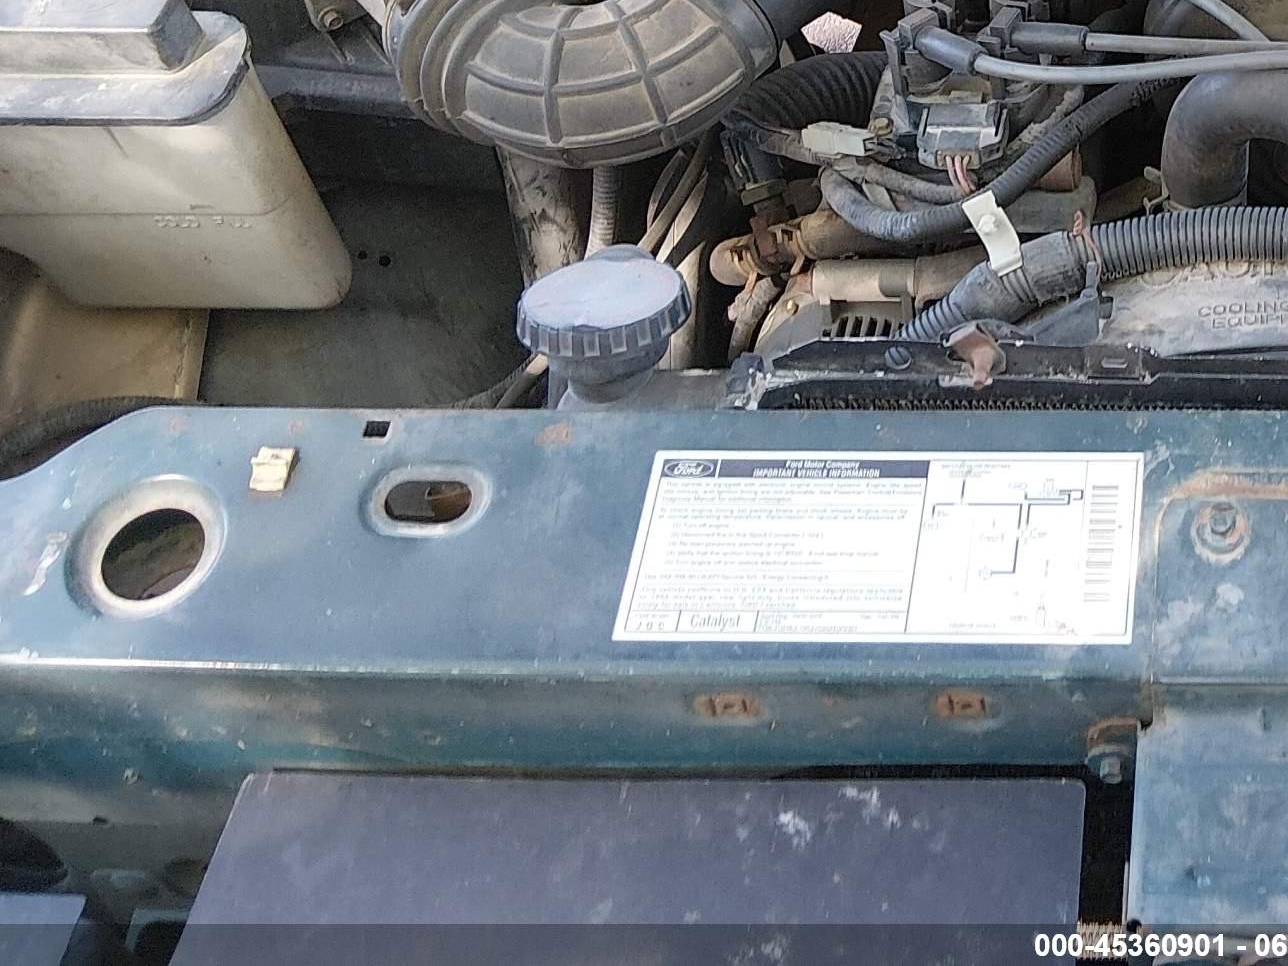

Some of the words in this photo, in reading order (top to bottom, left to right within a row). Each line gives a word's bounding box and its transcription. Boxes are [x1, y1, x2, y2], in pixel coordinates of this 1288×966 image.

[672, 462, 704, 476] Ford
[786, 460, 802, 468] Ford
[804, 461, 825, 469] Motor
[826, 461, 860, 470] Company
[753, 468, 796, 478] IMPORTANT
[797, 469, 827, 478] VEHICLE
[828, 469, 881, 479] INFORMATION
[690, 613, 741, 632] Catalyst
